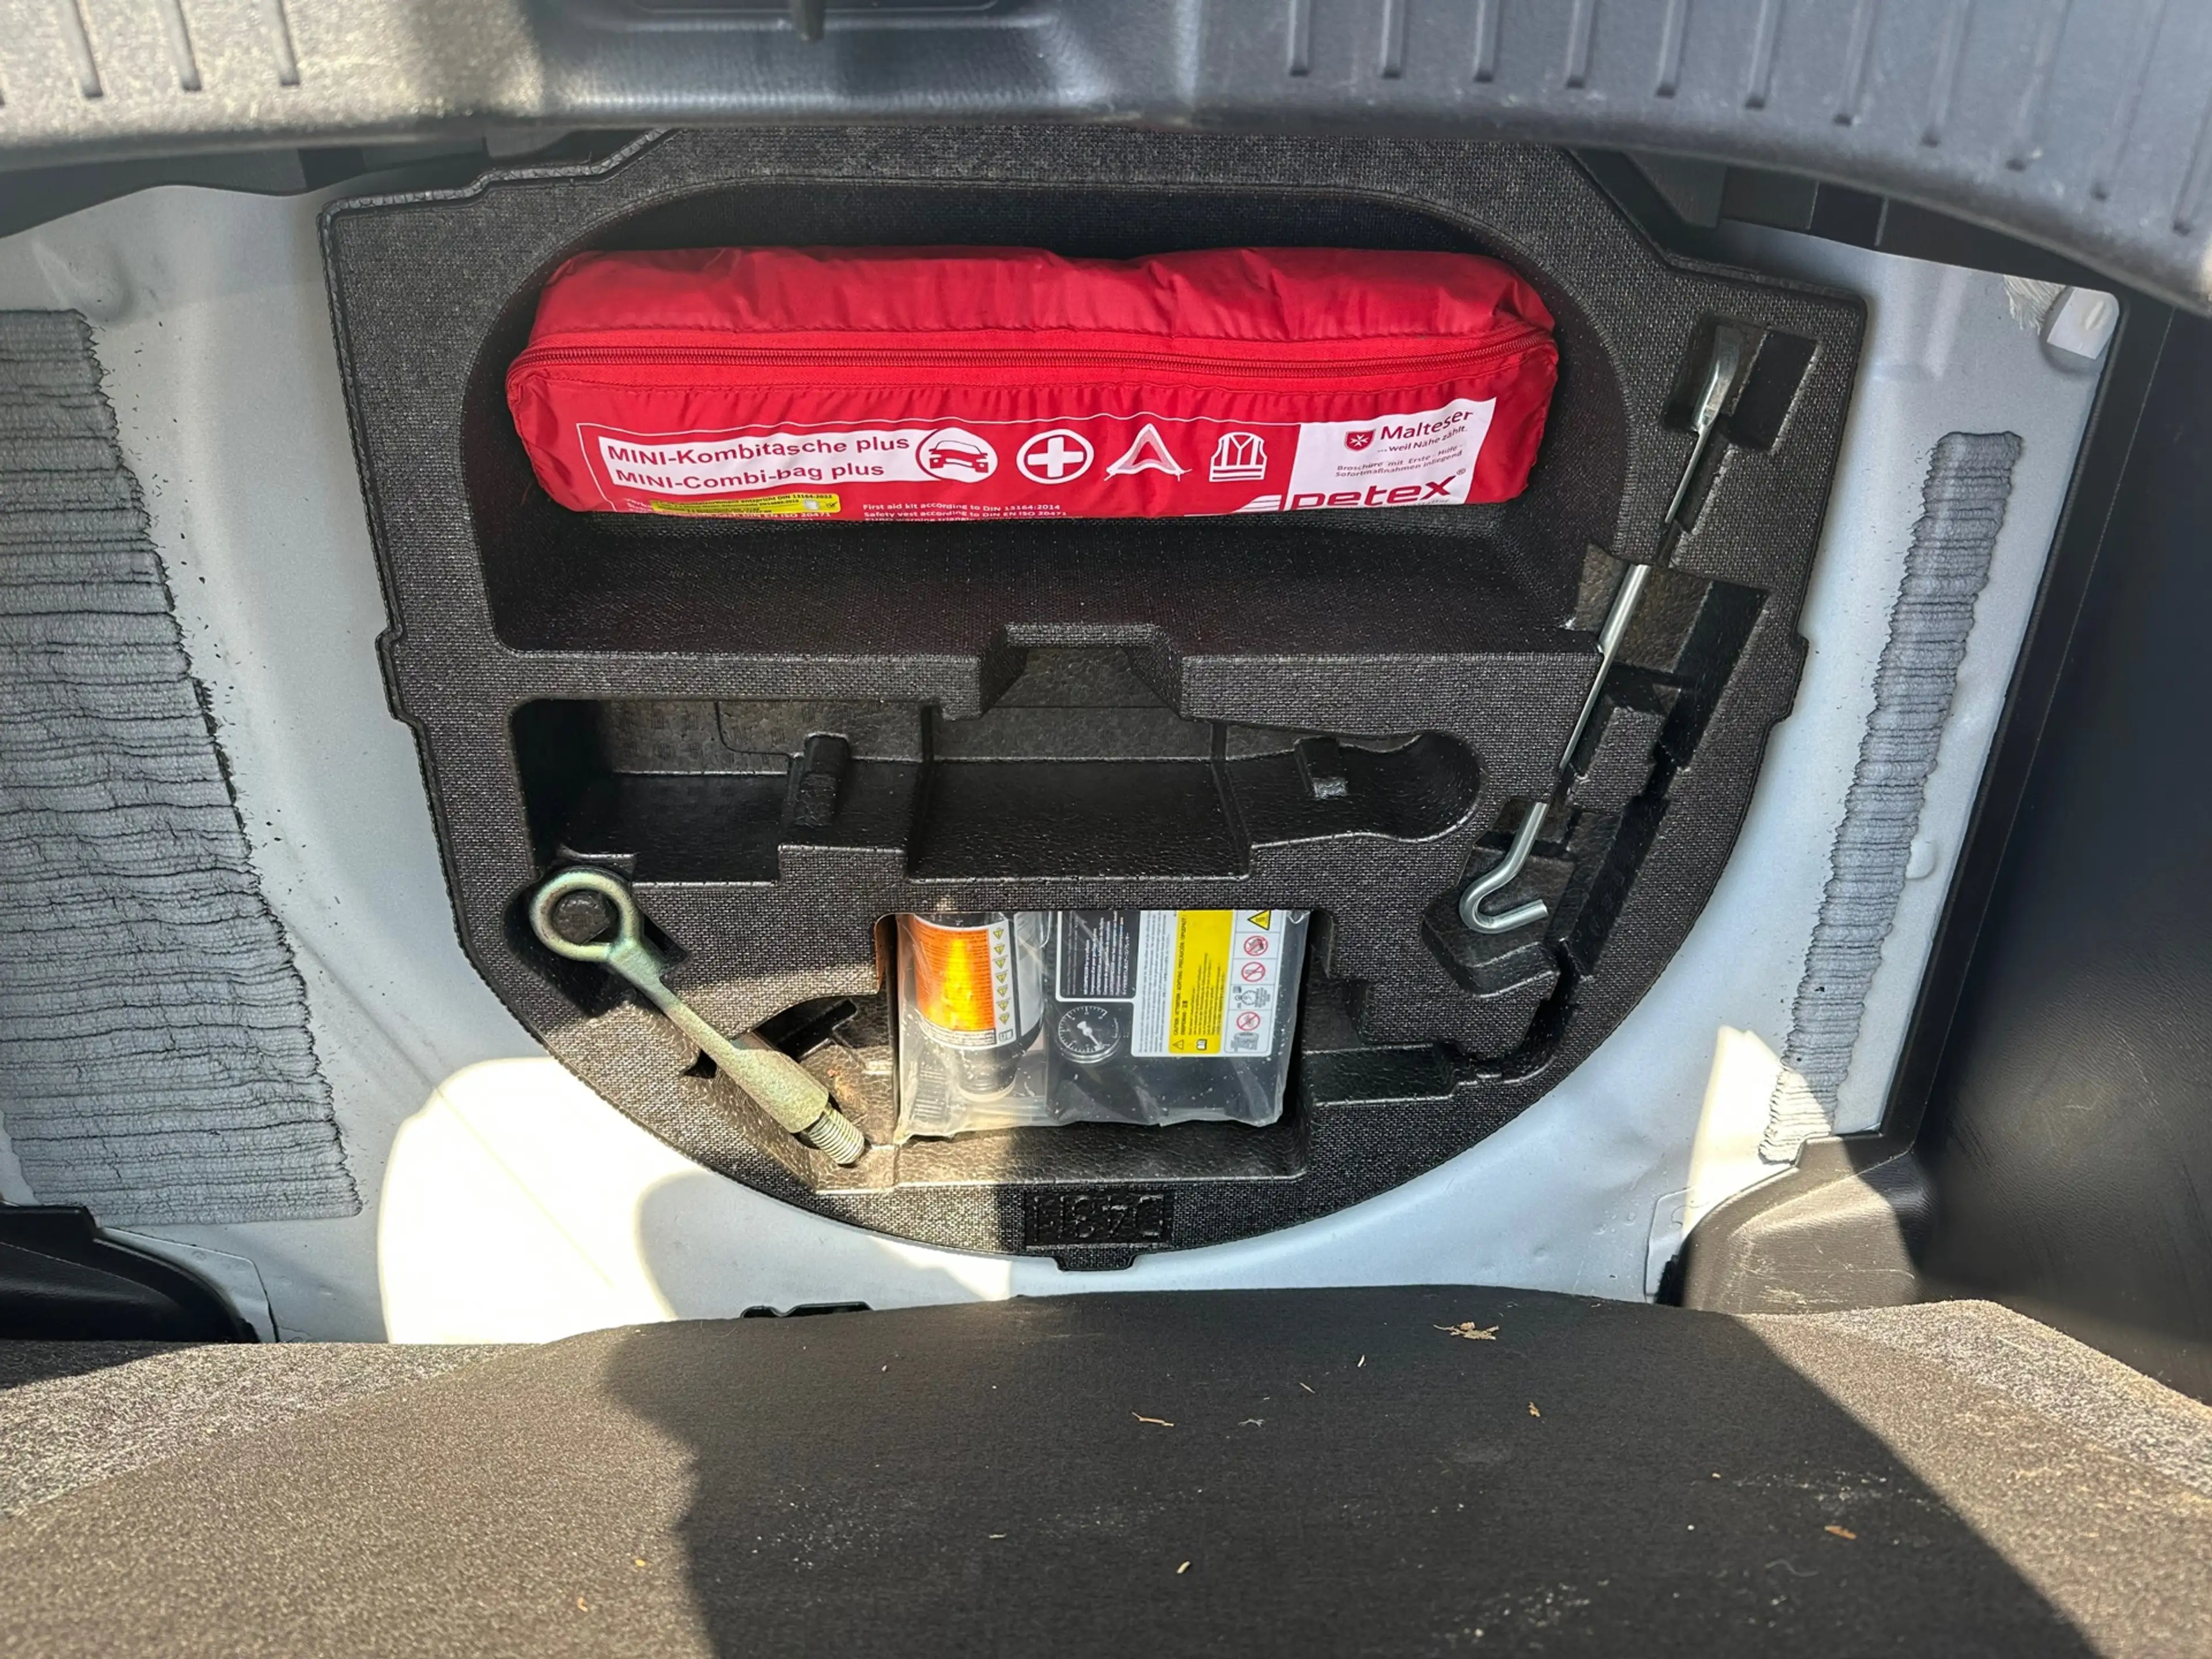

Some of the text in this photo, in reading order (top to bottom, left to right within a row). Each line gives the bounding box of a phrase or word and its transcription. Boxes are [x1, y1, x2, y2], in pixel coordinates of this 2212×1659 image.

[1380, 411, 1473, 441] Malteser
[608, 437, 910, 465] MINI-Kombitasche plus
[1414, 437, 1440, 449] Nähe
[1335, 451, 1463, 477] Sofortmaßnahmen inliegend
[1337, 461, 1384, 471] Broschüre
[1408, 454, 1431, 464] Erste
[1438, 446, 1459, 456] Hilfe
[615, 463, 884, 488] MINI-Combi-bag plus
[920, 502, 968, 510] according
